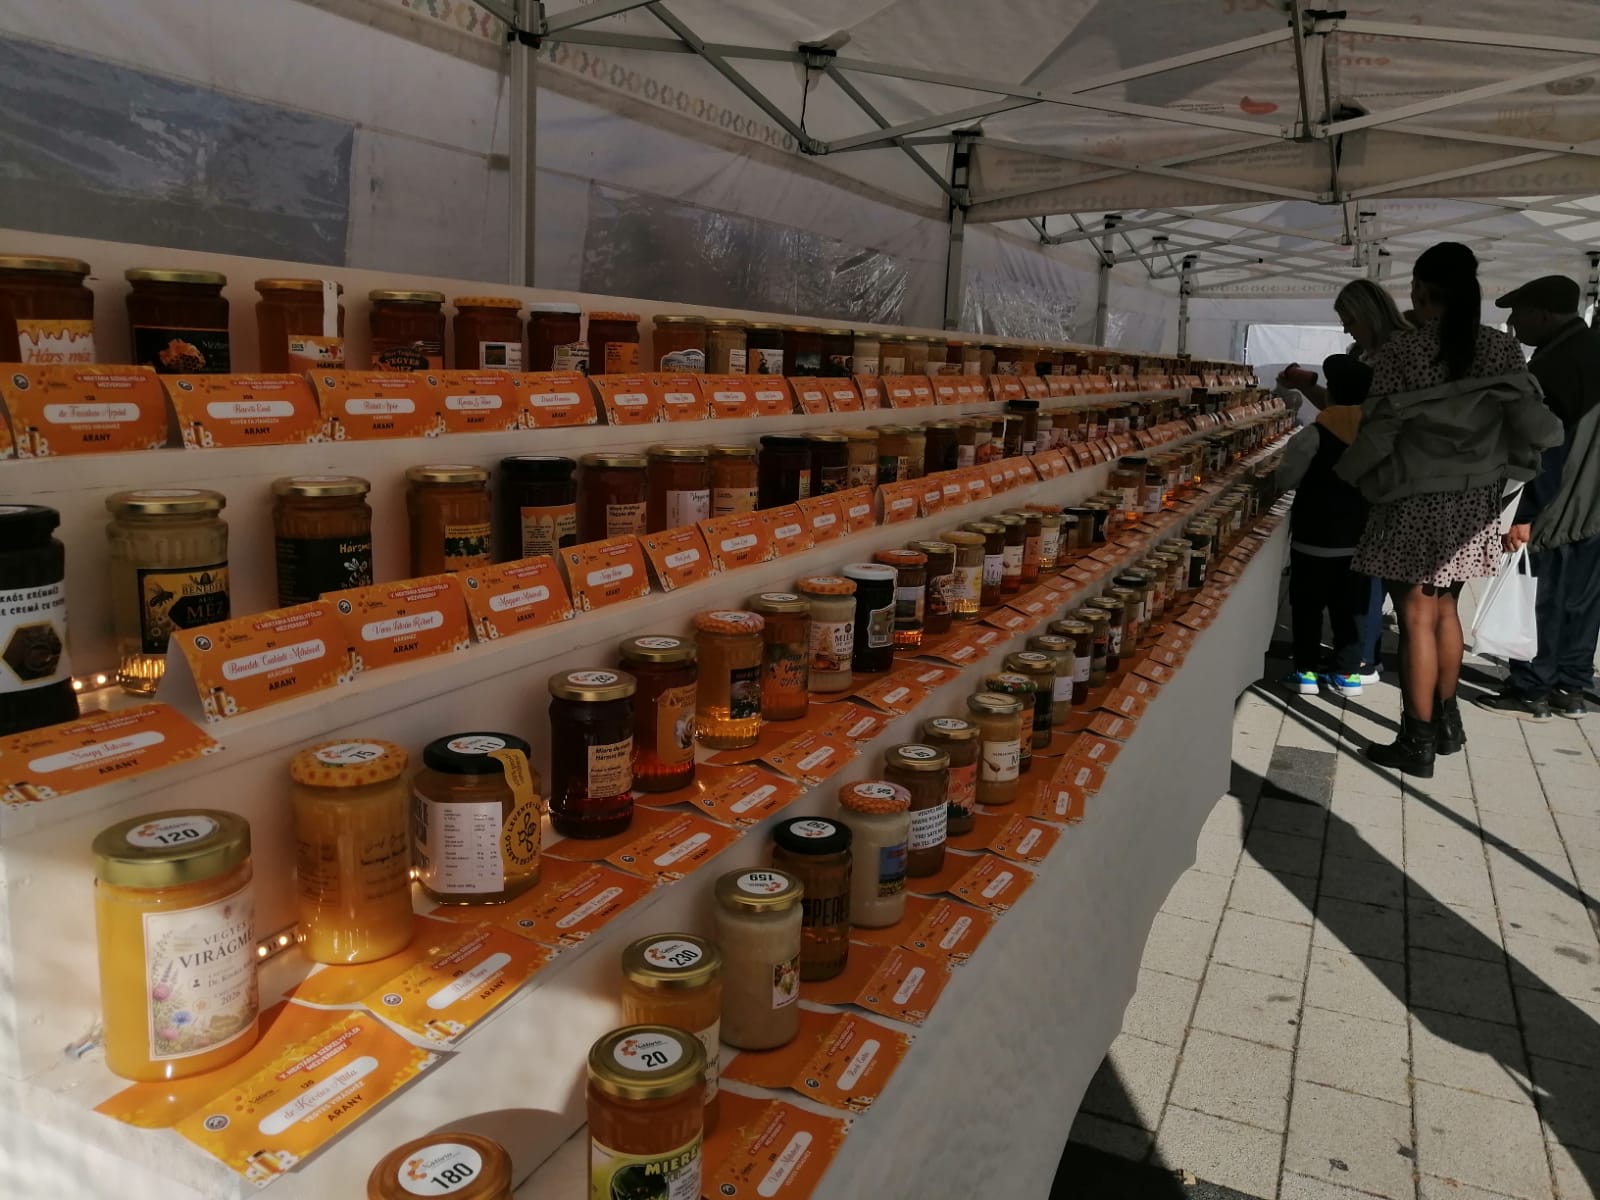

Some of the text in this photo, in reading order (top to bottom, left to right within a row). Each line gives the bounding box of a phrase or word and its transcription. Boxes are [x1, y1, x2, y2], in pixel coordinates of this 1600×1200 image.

[393, 642, 419, 654] ARANY
[268, 677, 297, 691] ARANY
[348, 750, 377, 760] 75
[473, 742, 502, 752] 111
[98, 759, 140, 775] ARANY
[154, 829, 200, 845] 120
[179, 926, 256, 969] VIRÁGMÉ
[668, 949, 700, 966] 230
[479, 979, 507, 1001] ARANY
[641, 1050, 669, 1068] 20
[327, 1093, 364, 1122] ARANY
[644, 1144, 698, 1177] MIERE
[430, 1162, 474, 1189] 180
